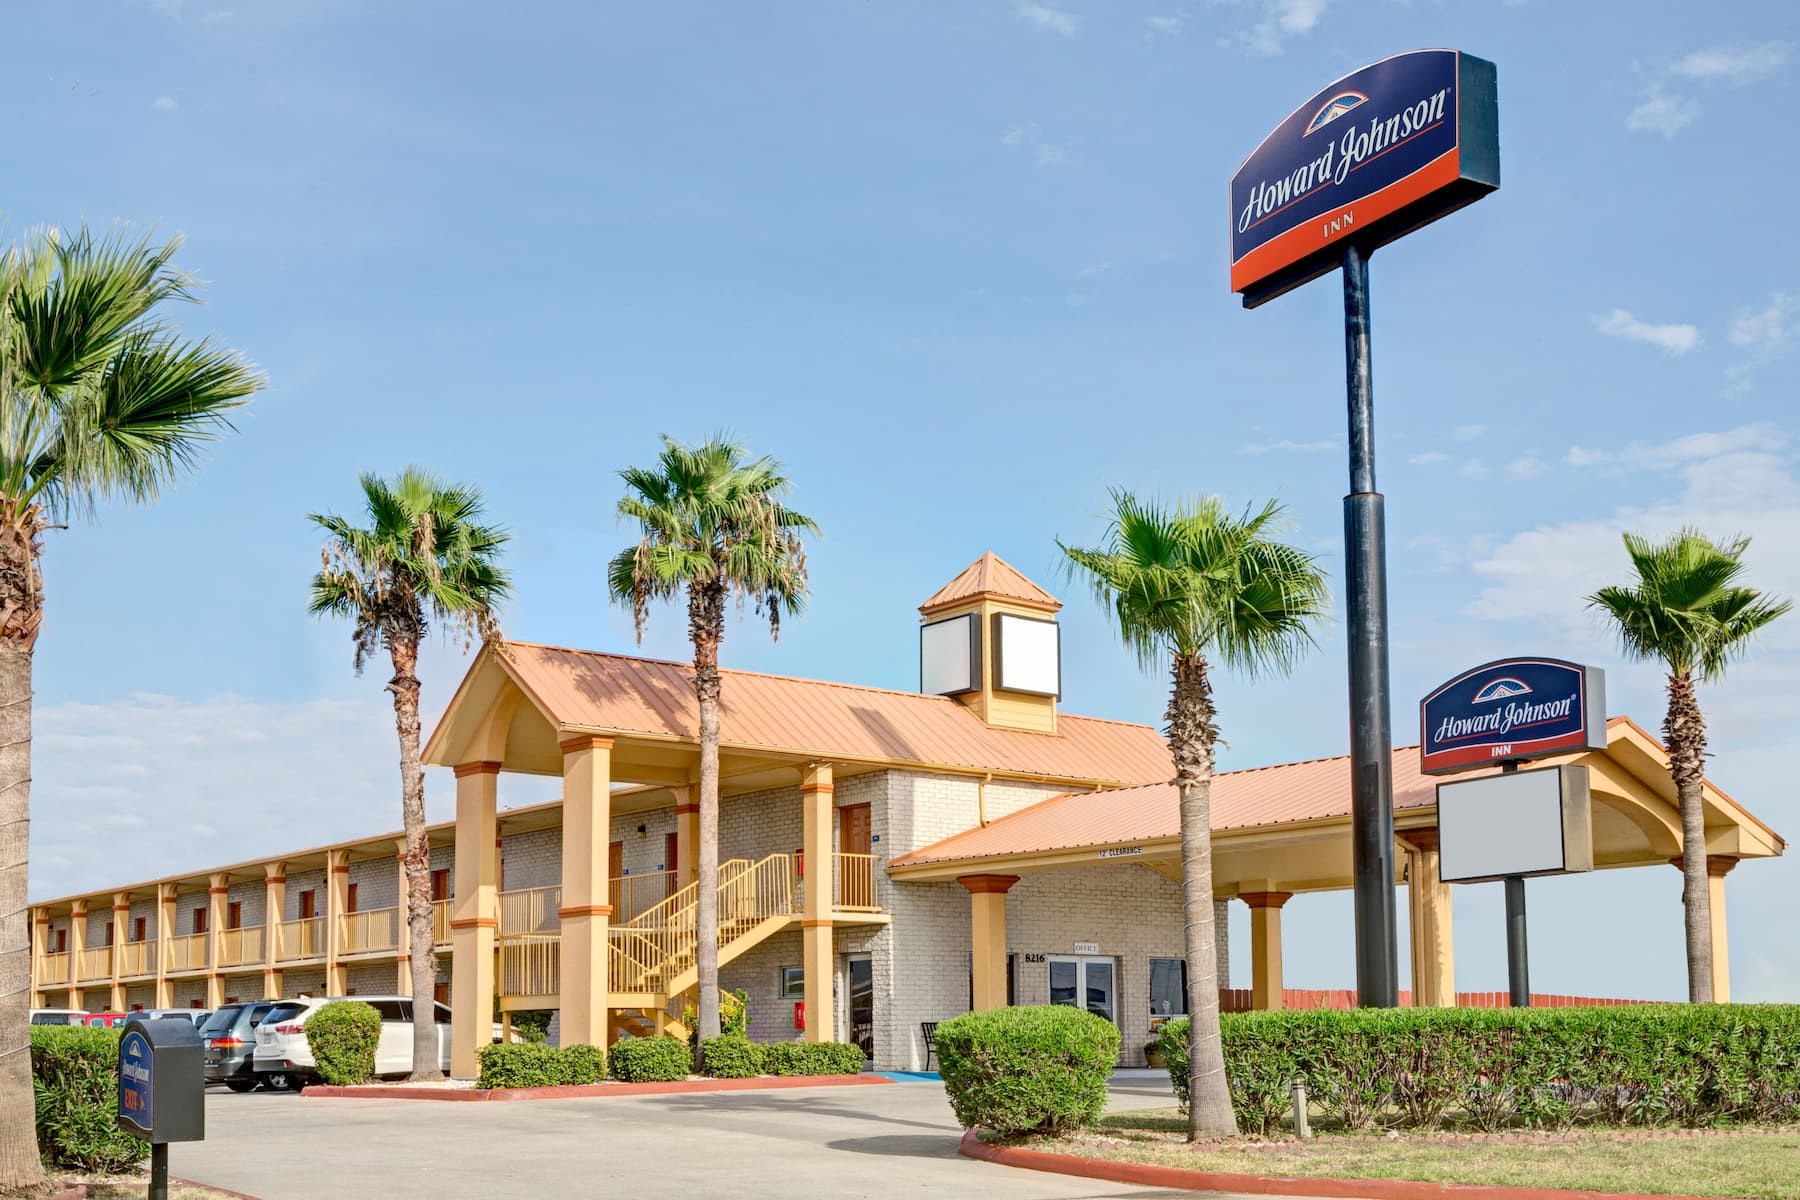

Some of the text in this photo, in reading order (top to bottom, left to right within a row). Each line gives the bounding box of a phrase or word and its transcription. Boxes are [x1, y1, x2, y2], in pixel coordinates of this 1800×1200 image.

[1238, 91, 1448, 234] Howard Johnson
[1323, 210, 1355, 239] INN
[1434, 698, 1571, 743] Howard Johnson
[1491, 744, 1512, 757] INN
[1109, 845, 1143, 856] CLEARANCE
[1025, 952, 1045, 963] 8216
